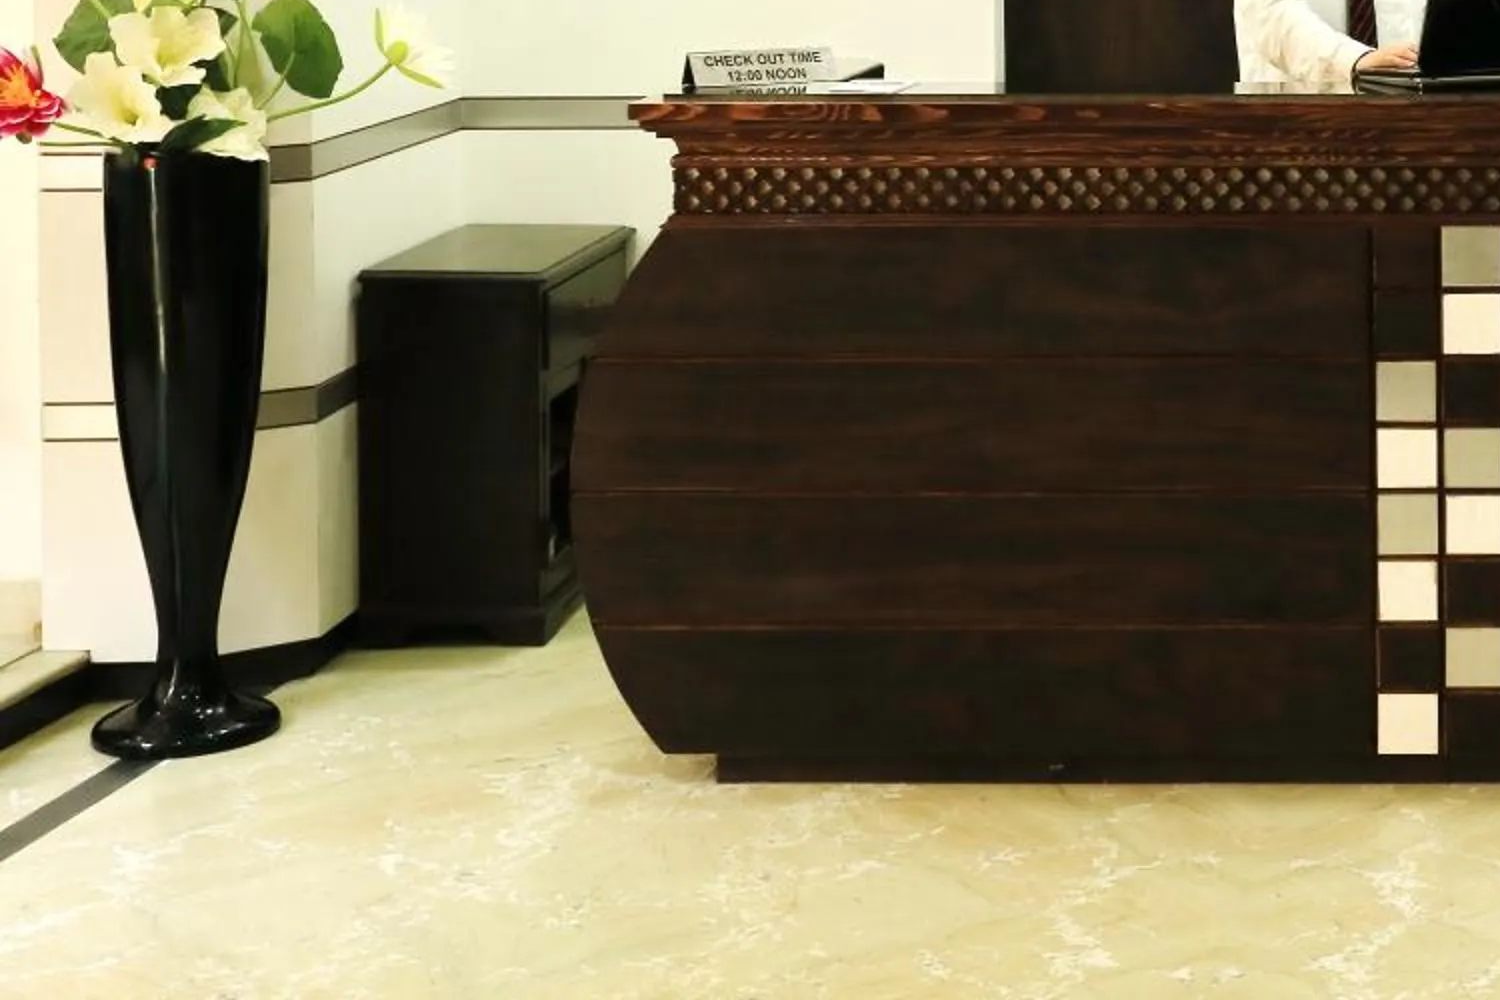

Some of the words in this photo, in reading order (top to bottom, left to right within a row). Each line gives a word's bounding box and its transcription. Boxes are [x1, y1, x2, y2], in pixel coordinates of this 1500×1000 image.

[703, 55, 754, 67] CHECK
[756, 53, 784, 66] OUT
[790, 51, 823, 64] TIME
[727, 70, 763, 82] 12:00
[765, 68, 807, 81] NOON
